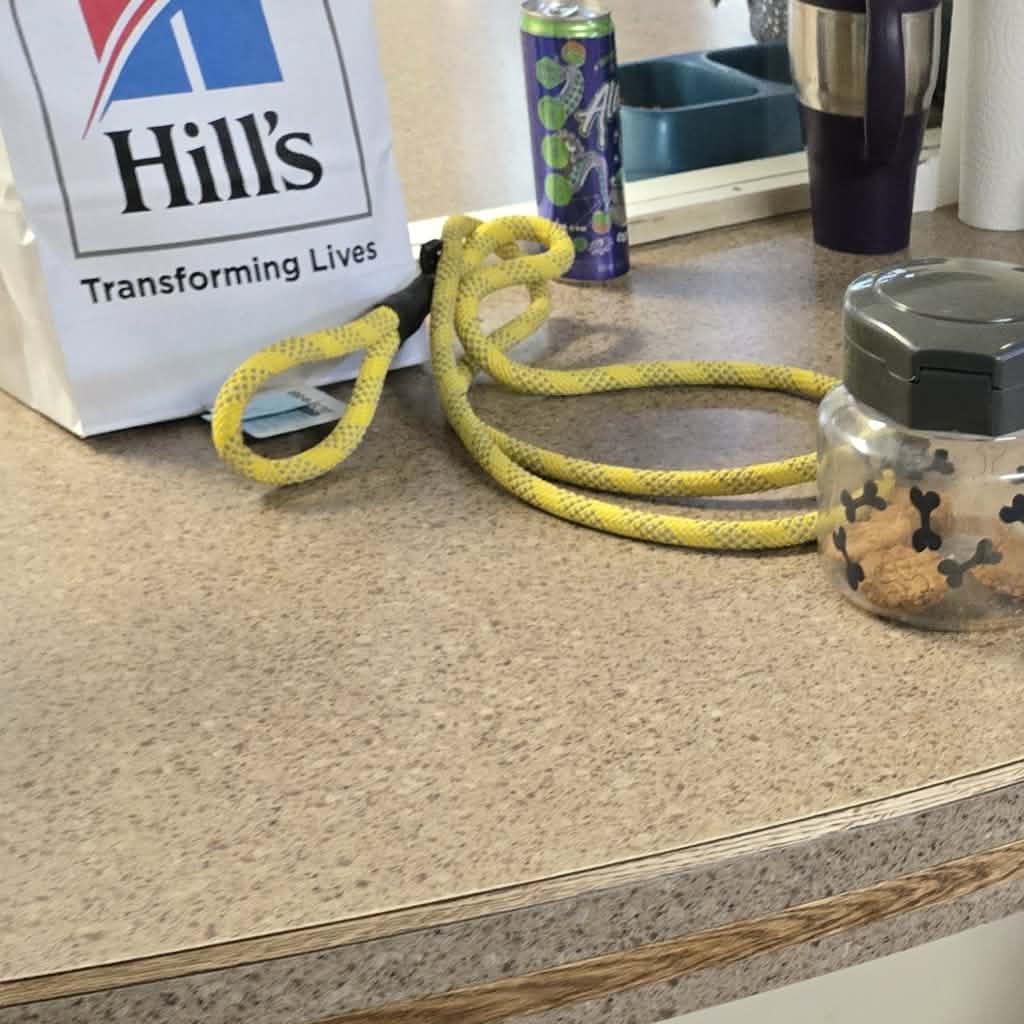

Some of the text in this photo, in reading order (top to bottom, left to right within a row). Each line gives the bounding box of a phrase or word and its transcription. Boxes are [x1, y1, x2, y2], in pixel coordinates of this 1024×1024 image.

[104, 111, 323, 214] Hill's
[81, 240, 378, 304] Transforming Lives
